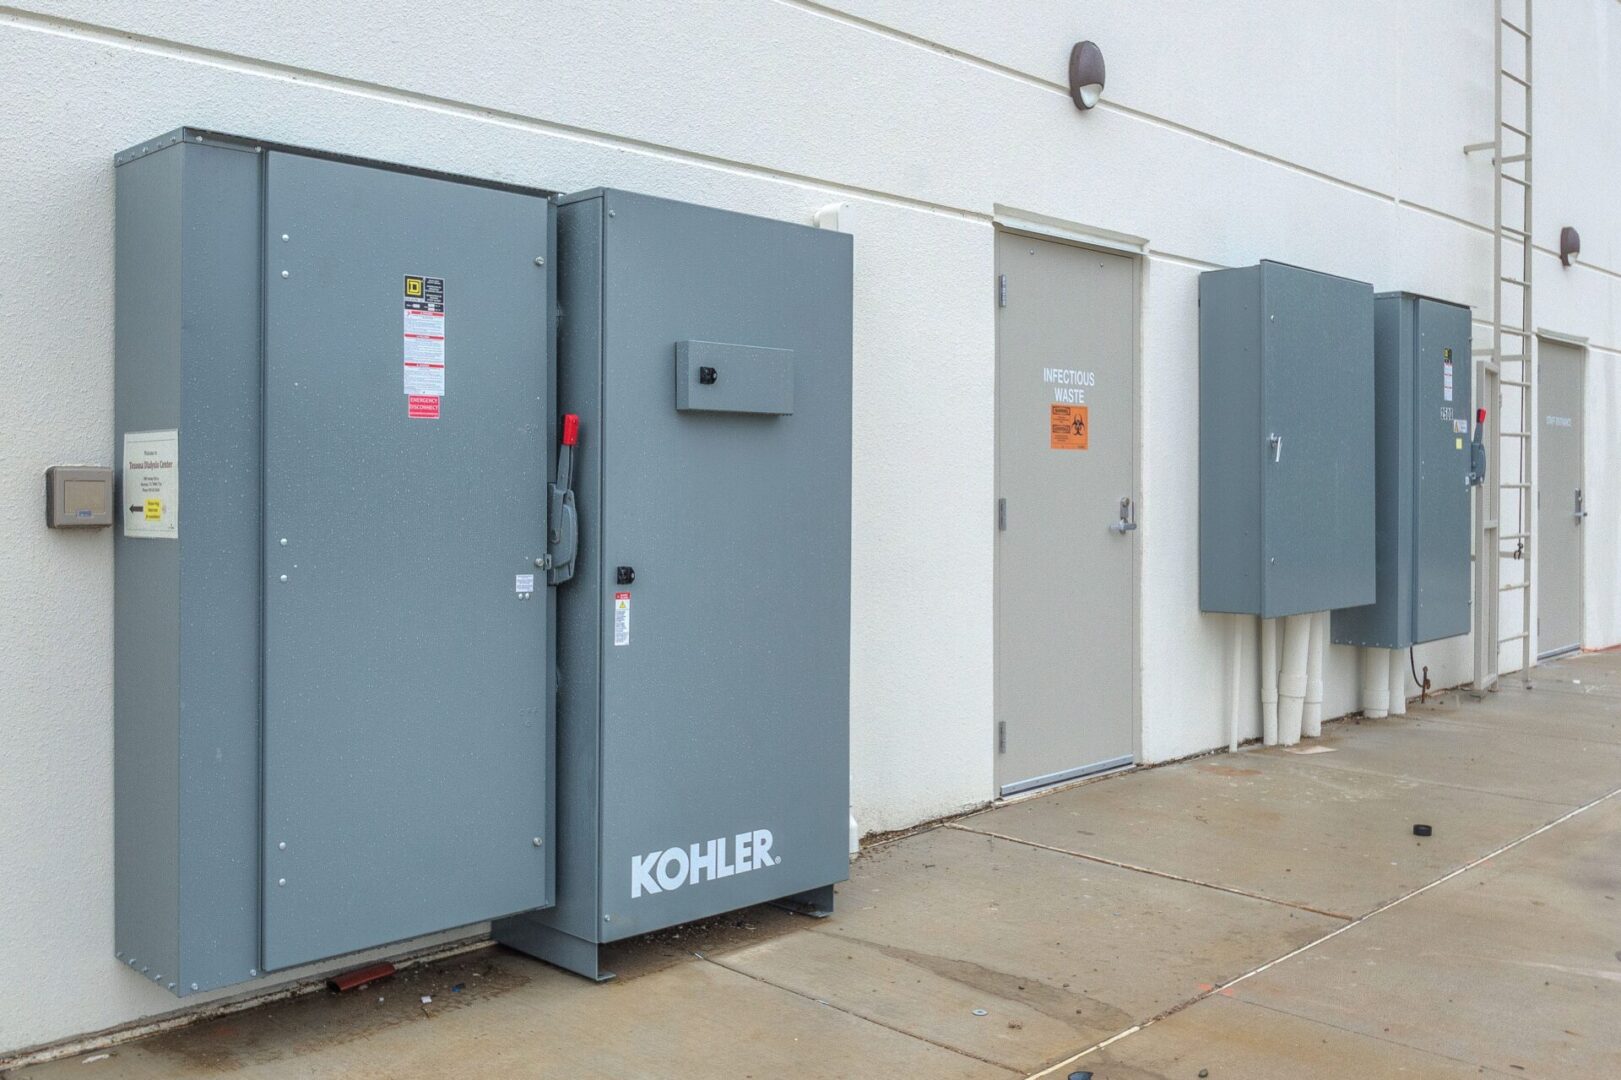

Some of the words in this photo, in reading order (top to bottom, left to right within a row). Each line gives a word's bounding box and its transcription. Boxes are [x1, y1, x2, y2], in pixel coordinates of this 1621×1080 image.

[1043, 367, 1095, 386] INFECTIOUS
[1054, 387, 1085, 404] WASTE
[160, 460, 173, 469] Center
[631, 828, 776, 899] KOHLER
